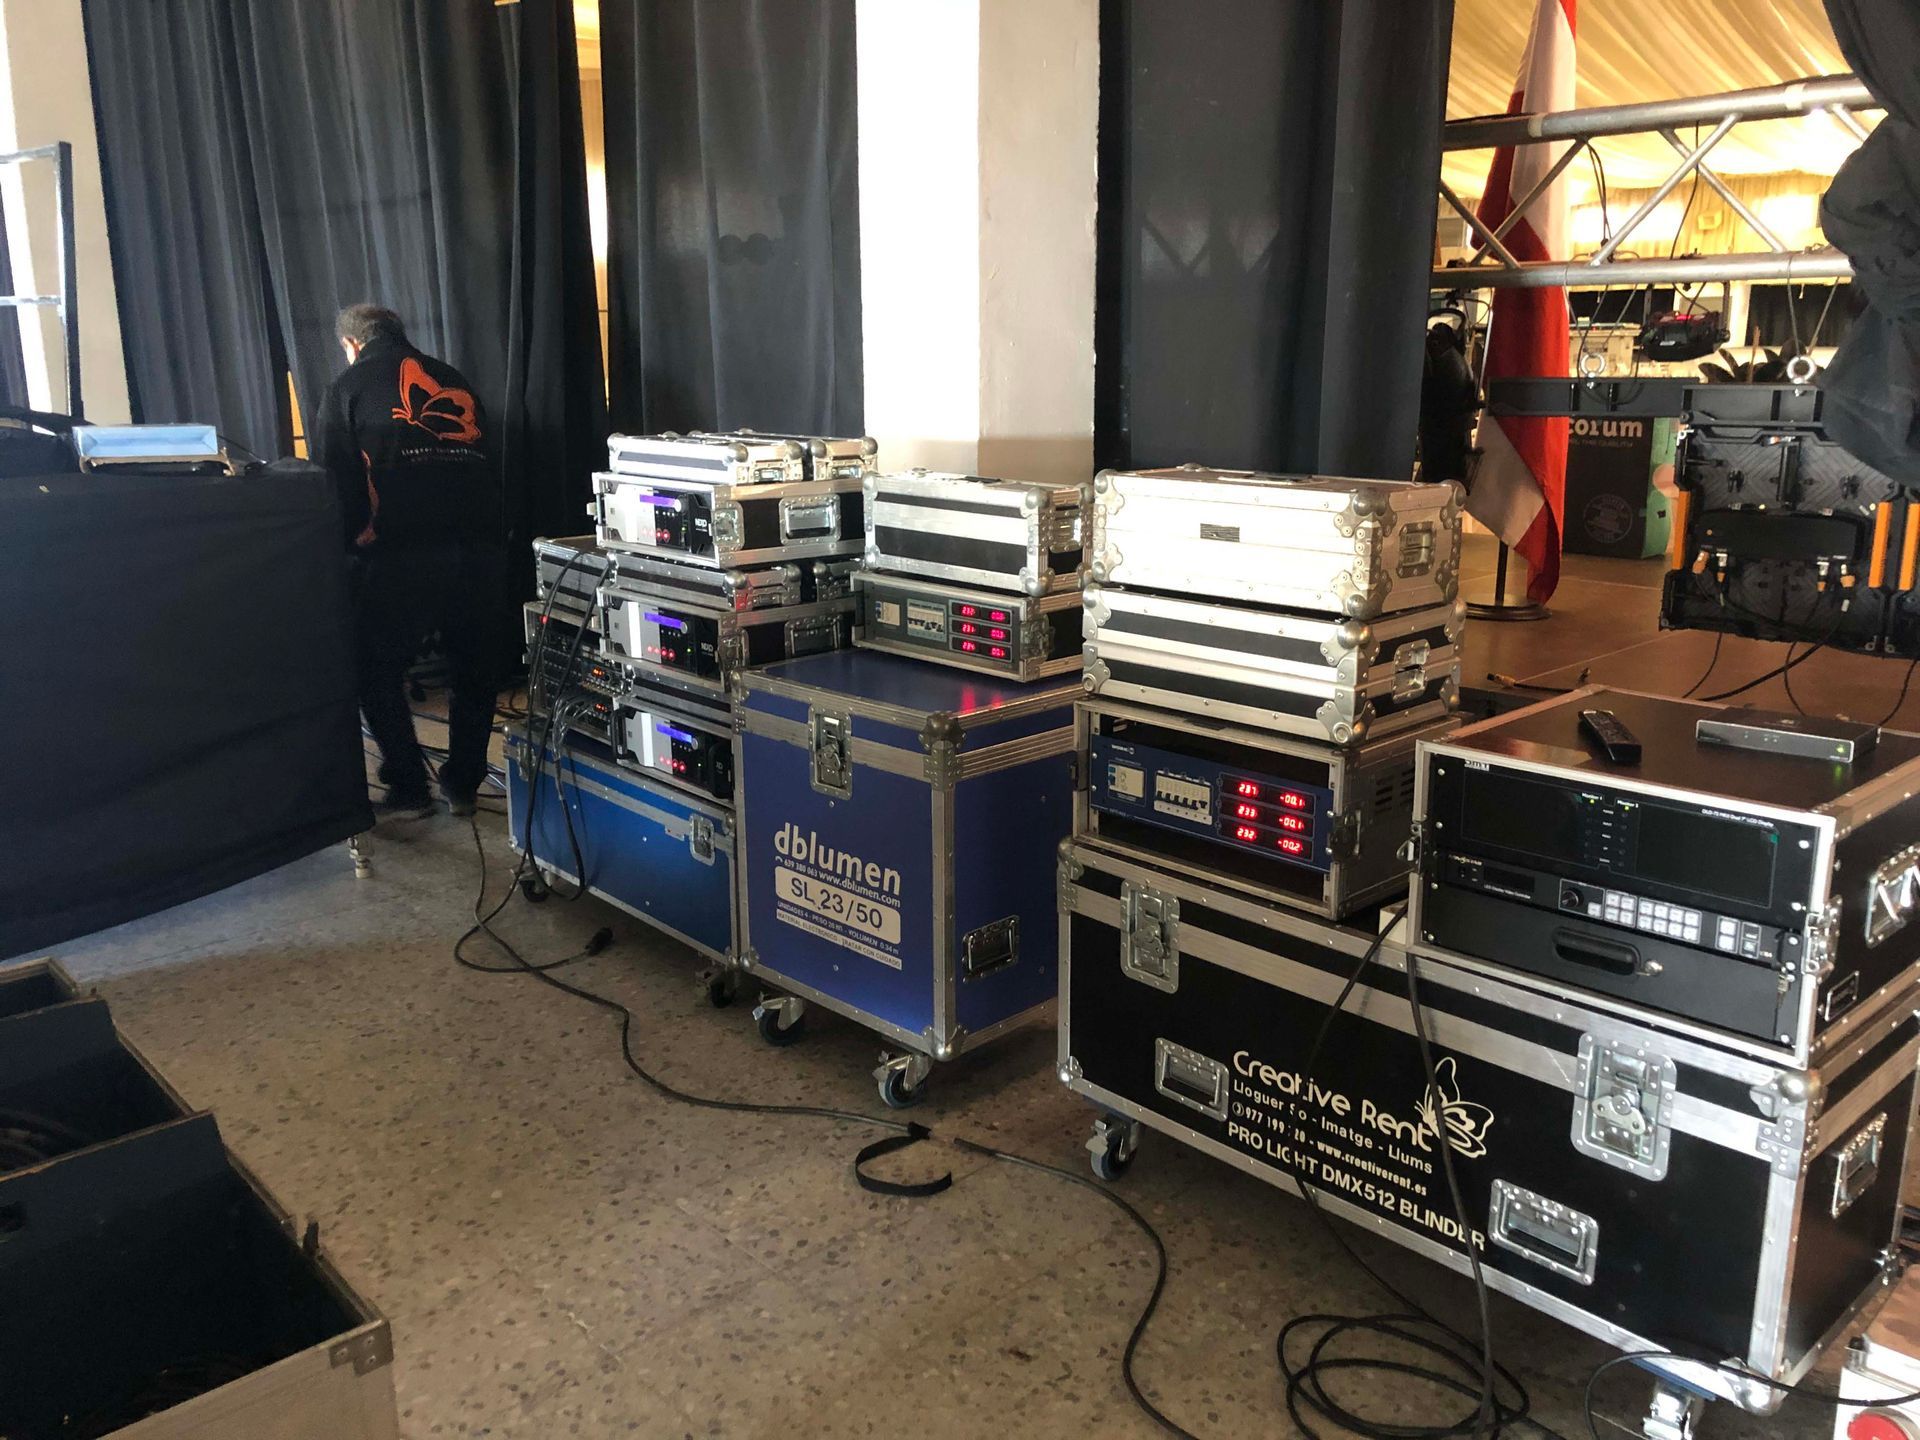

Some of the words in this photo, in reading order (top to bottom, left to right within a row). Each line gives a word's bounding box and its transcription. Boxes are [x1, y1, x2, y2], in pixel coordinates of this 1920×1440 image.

[774, 822, 901, 896] dblumen
[819, 871, 901, 908] www.dblumen.com
[847, 928, 878, 947] VOLUMEN
[862, 947, 876, 957] CON
[875, 952, 902, 969] CUIDADO
[1233, 1050, 1351, 1116] Creative
[1361, 1099, 1433, 1153] Rent
[1233, 1078, 1285, 1112] Lloguer
[1321, 1116, 1374, 1150] Imatge
[1388, 1143, 1433, 1175] Llums
[1228, 1121, 1263, 1150] PRO
[1322, 1163, 1396, 1212] DMX512
[1245, 1106, 1263, 1124] 977
[1317, 1140, 1428, 1197] www.creativerent.es
